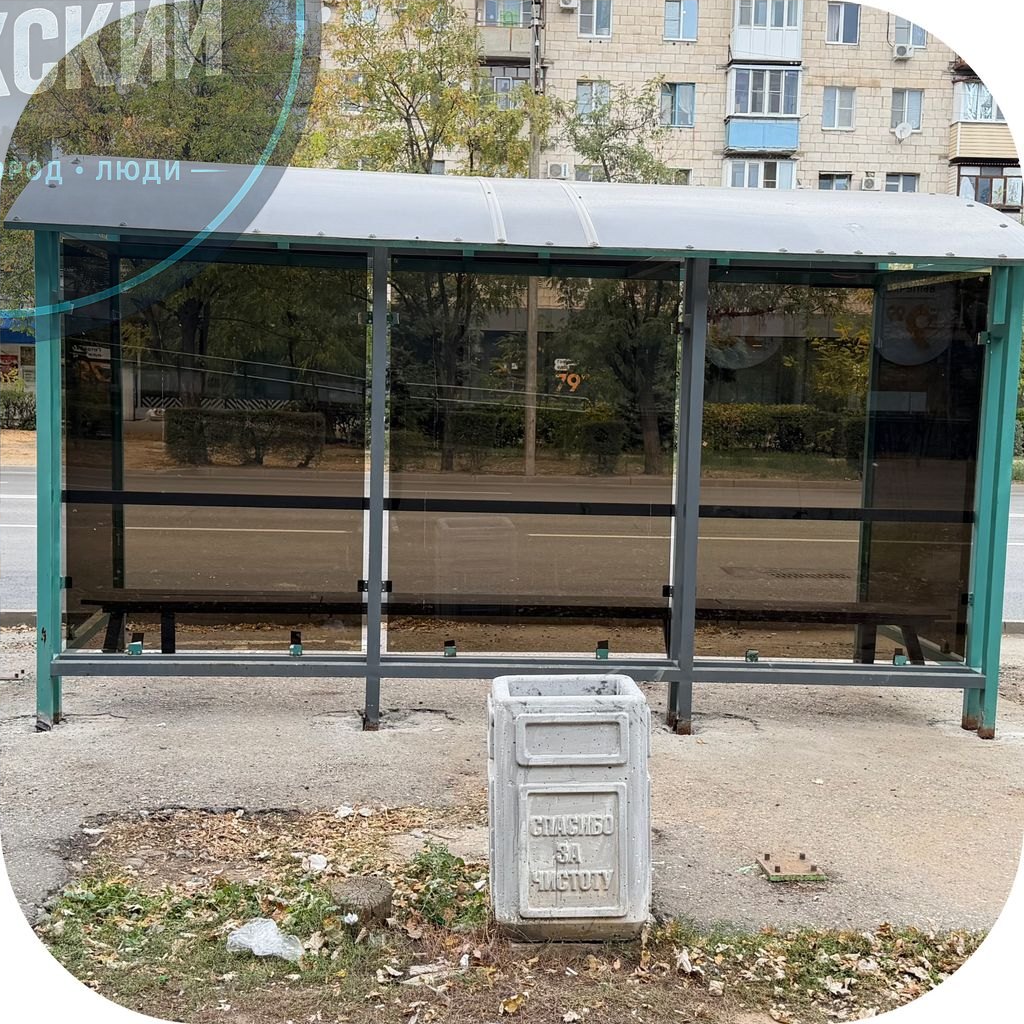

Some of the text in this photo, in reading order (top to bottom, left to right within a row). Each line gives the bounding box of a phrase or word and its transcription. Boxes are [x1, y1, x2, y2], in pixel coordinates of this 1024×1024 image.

[529, 814, 615, 837] СПАСИБО
[554, 842, 581, 864] ЗА
[530, 869, 613, 892] ЧИСТОТУ
